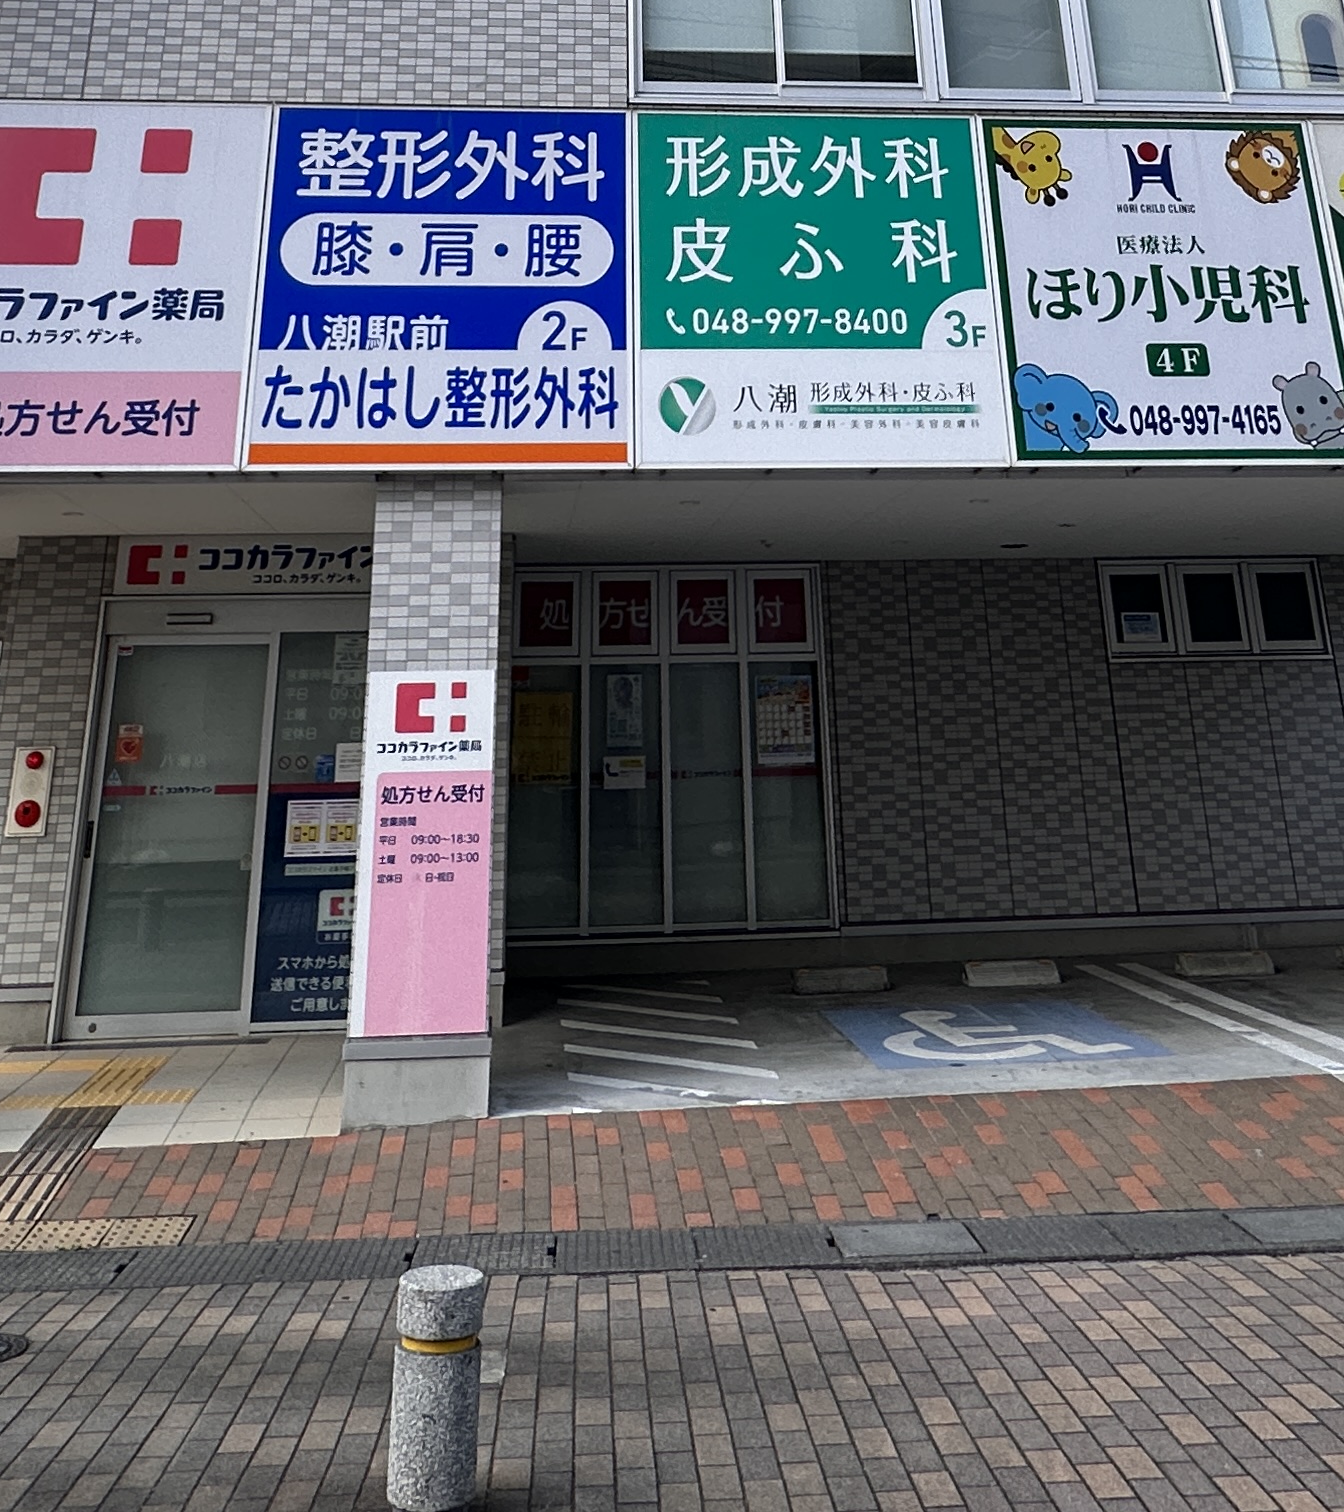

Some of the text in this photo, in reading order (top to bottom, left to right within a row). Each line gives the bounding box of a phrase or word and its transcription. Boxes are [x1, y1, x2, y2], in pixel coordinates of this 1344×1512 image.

[297, 127, 605, 202] 整形外科
[665, 135, 949, 199] 形成外科
[1116, 204, 1196, 214] HORI CHILD CLINIC
[312, 221, 583, 278] 膝・肩・腰
[665, 218, 958, 283] 皮ふ科
[1116, 235, 1206, 255] 医療法人
[1026, 263, 1311, 325] ほり小児科
[278, 313, 449, 351] 八潮駅前
[541, 310, 587, 351] 2F
[692, 307, 908, 336] 048-997-8400
[944, 310, 987, 348] 3F
[1155, 348, 1202, 375] 4F
[262, 364, 619, 431] たかはし整形外科
[733, 382, 977, 414] 八潮 形成外科・皮ふ科
[1129, 403, 1283, 438] 048-997-4165
[540, 594, 784, 630] 処方せん受付
[376, 739, 482, 754] ココカラファイン薬局
[381, 784, 485, 805] 処方せん受付
[379, 836, 396, 845] 平日
[270, 976, 351, 992] 送信できる便
